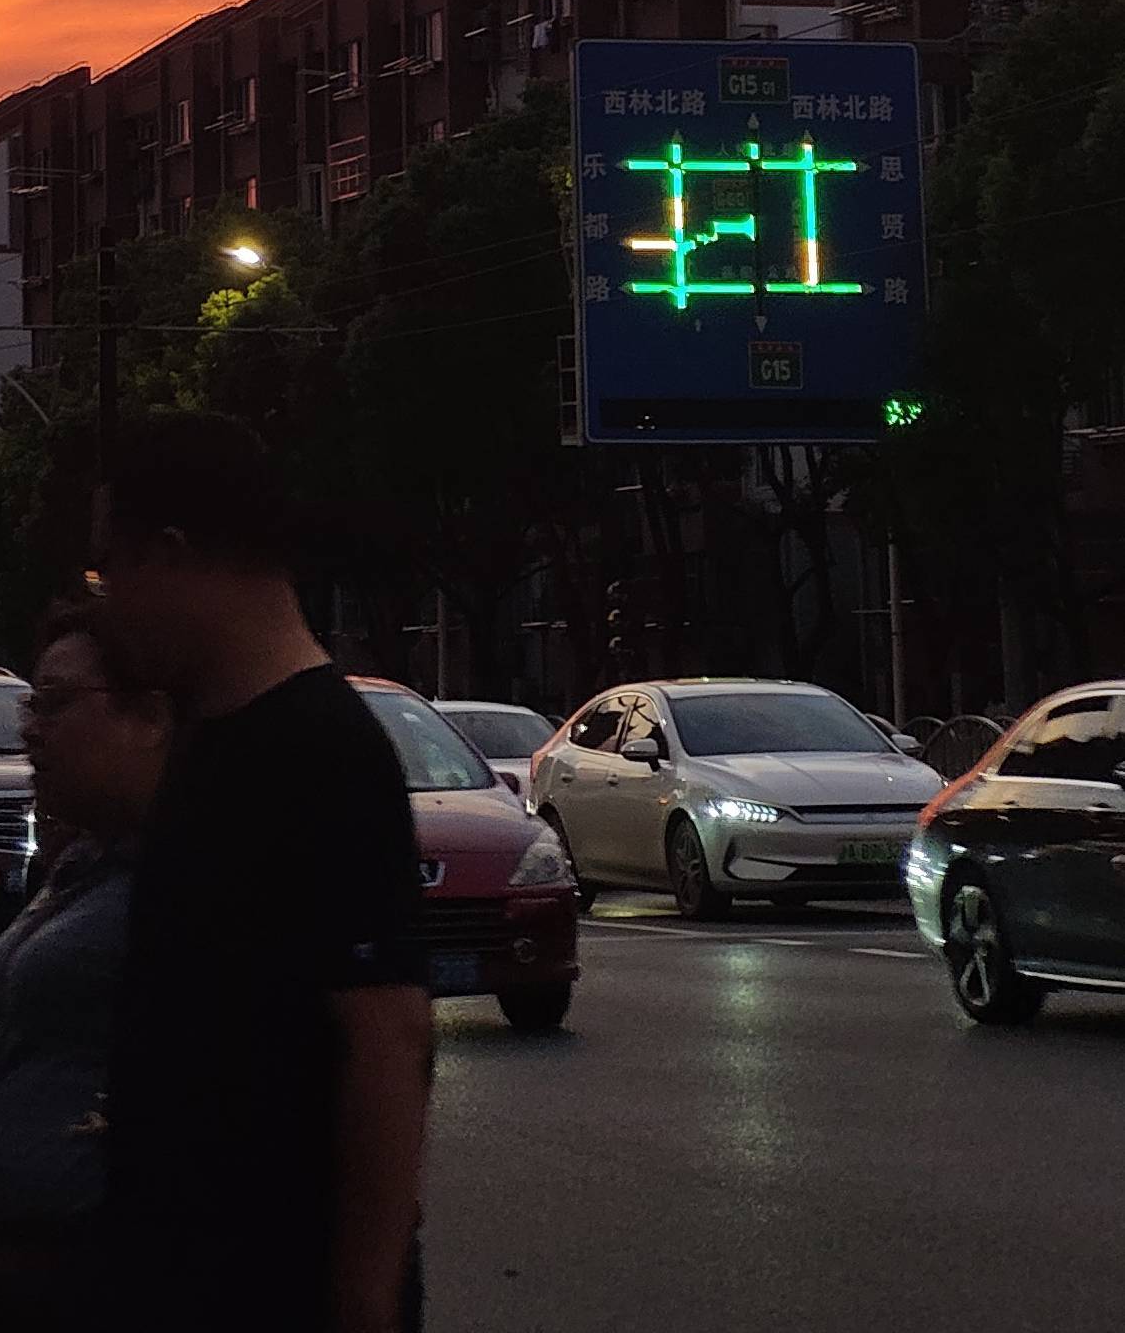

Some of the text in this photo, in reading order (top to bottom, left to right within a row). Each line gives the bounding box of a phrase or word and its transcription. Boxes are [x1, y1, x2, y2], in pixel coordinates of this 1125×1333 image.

[603, 89, 708, 117] 西林北路
[791, 94, 894, 122] 西林北路
[582, 154, 611, 302] 乐都路
[879, 156, 909, 305] 思贤路
[760, 359, 792, 381] G15
